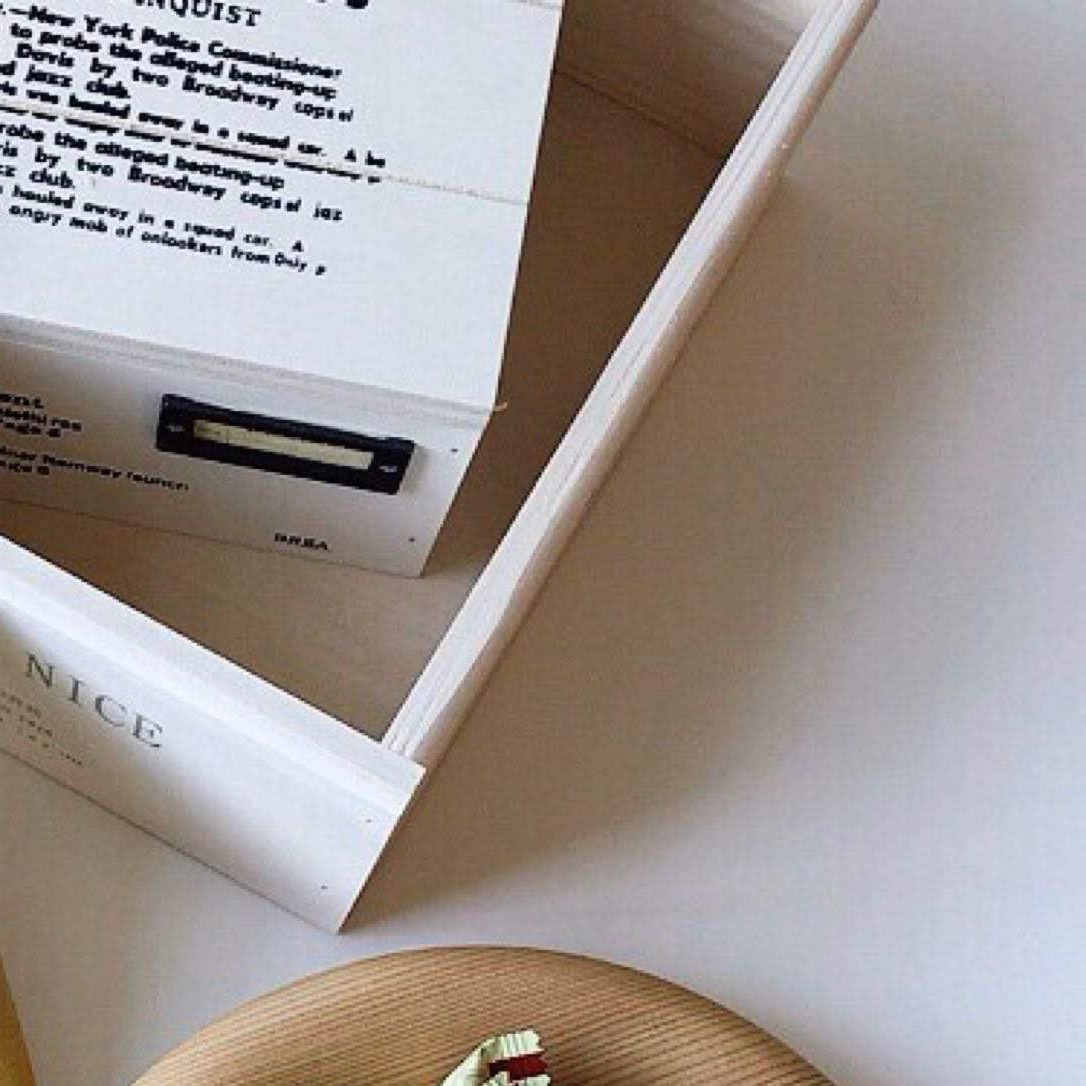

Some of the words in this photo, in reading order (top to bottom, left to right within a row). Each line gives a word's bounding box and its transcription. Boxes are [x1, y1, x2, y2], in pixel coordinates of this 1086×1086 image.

[10, 22, 33, 39] to
[109, 42, 143, 61] the
[89, 56, 117, 79] by
[131, 65, 170, 88] two
[181, 74, 281, 111] Broadway
[33, 145, 62, 169] by
[76, 155, 115, 178] two
[127, 164, 227, 201] Broadway
[53, 130, 89, 152] the
[94, 140, 170, 167] alleged
[174, 155, 286, 193] beating-up
[7, 203, 63, 228] angry
[12, 183, 77, 210] hauled
[25, 651, 164, 749] NICE
